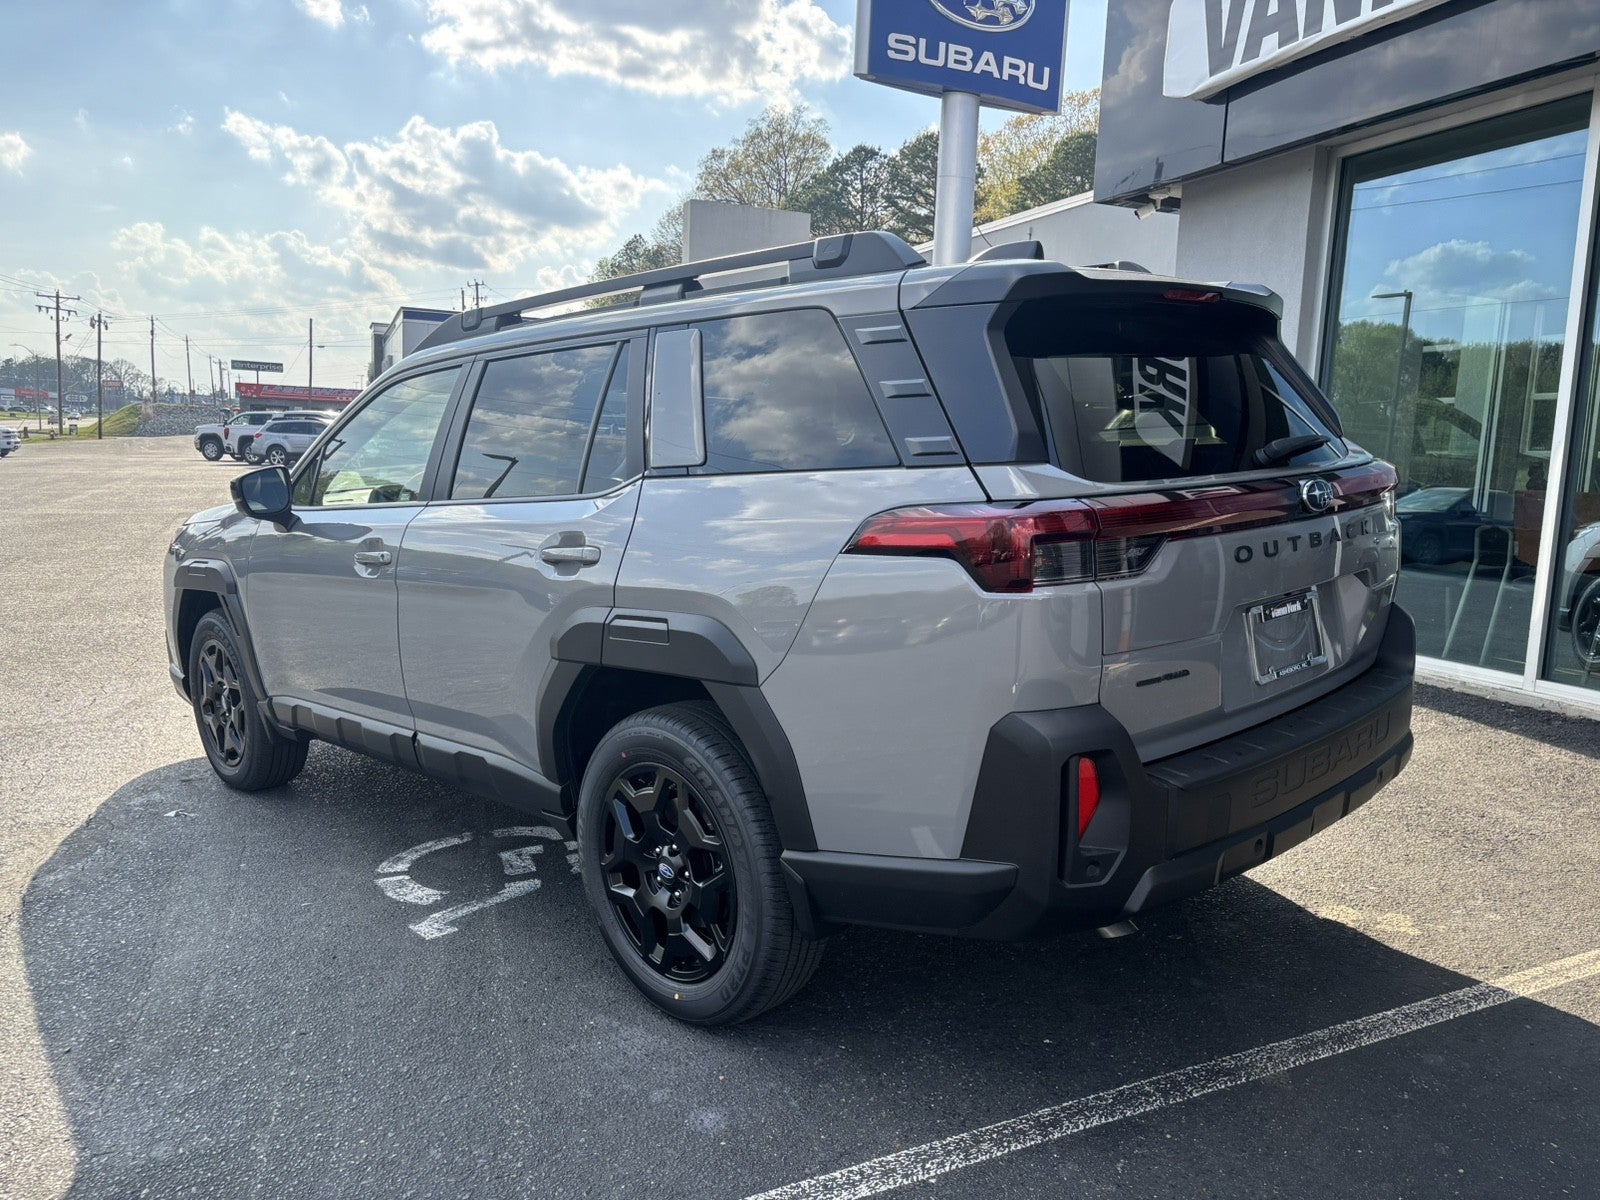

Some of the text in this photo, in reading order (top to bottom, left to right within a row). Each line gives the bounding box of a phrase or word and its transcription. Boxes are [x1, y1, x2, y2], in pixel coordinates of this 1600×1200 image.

[887, 33, 1050, 91] SUBARU
[232, 361, 283, 371] enterprise
[1234, 520, 1369, 563] OUTBACK
[1253, 711, 1391, 808] SUBARU
